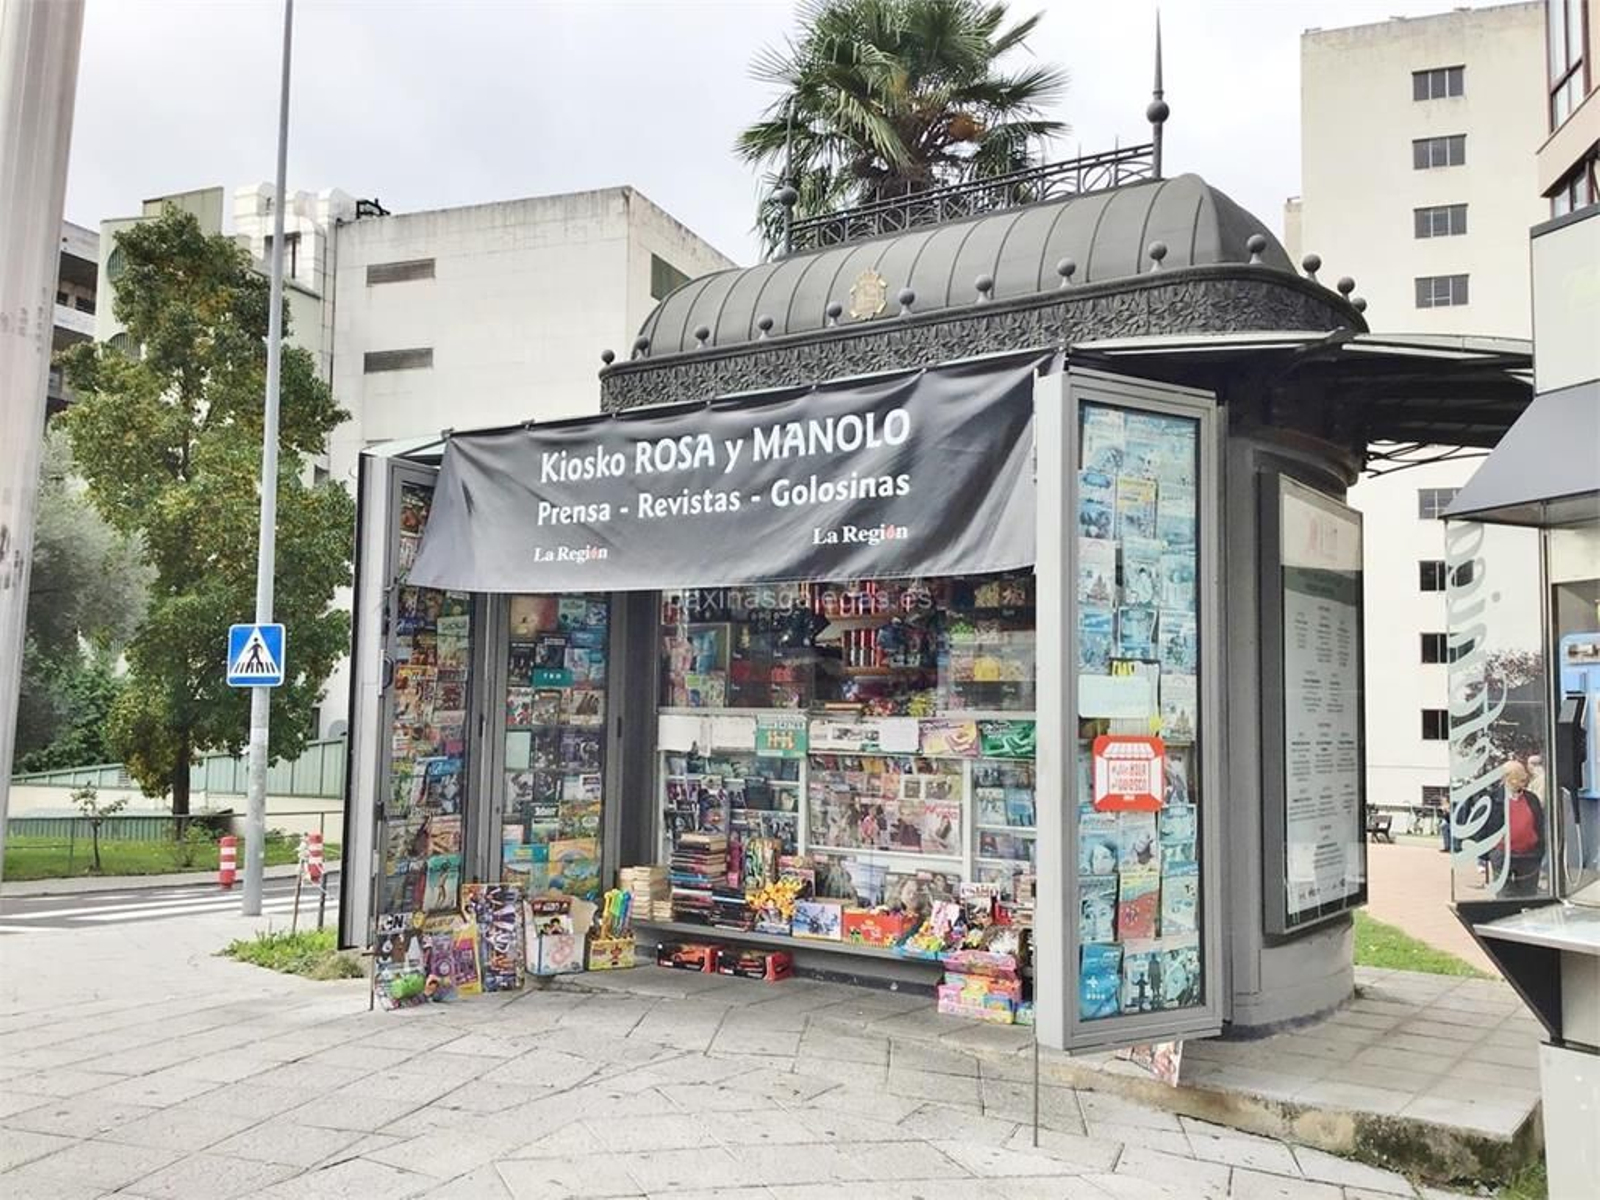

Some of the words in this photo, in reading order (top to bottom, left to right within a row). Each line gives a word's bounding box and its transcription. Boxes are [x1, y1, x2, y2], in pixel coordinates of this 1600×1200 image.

[540, 445, 626, 483] Kiosko
[635, 434, 715, 474] ROSA
[724, 438, 744, 474] y
[752, 408, 911, 462] MANOLO
[537, 501, 611, 526] Prensa
[637, 488, 741, 519] Revistas
[770, 471, 911, 507] Golosinas
[811, 526, 838, 545] La
[533, 547, 554, 563] La
